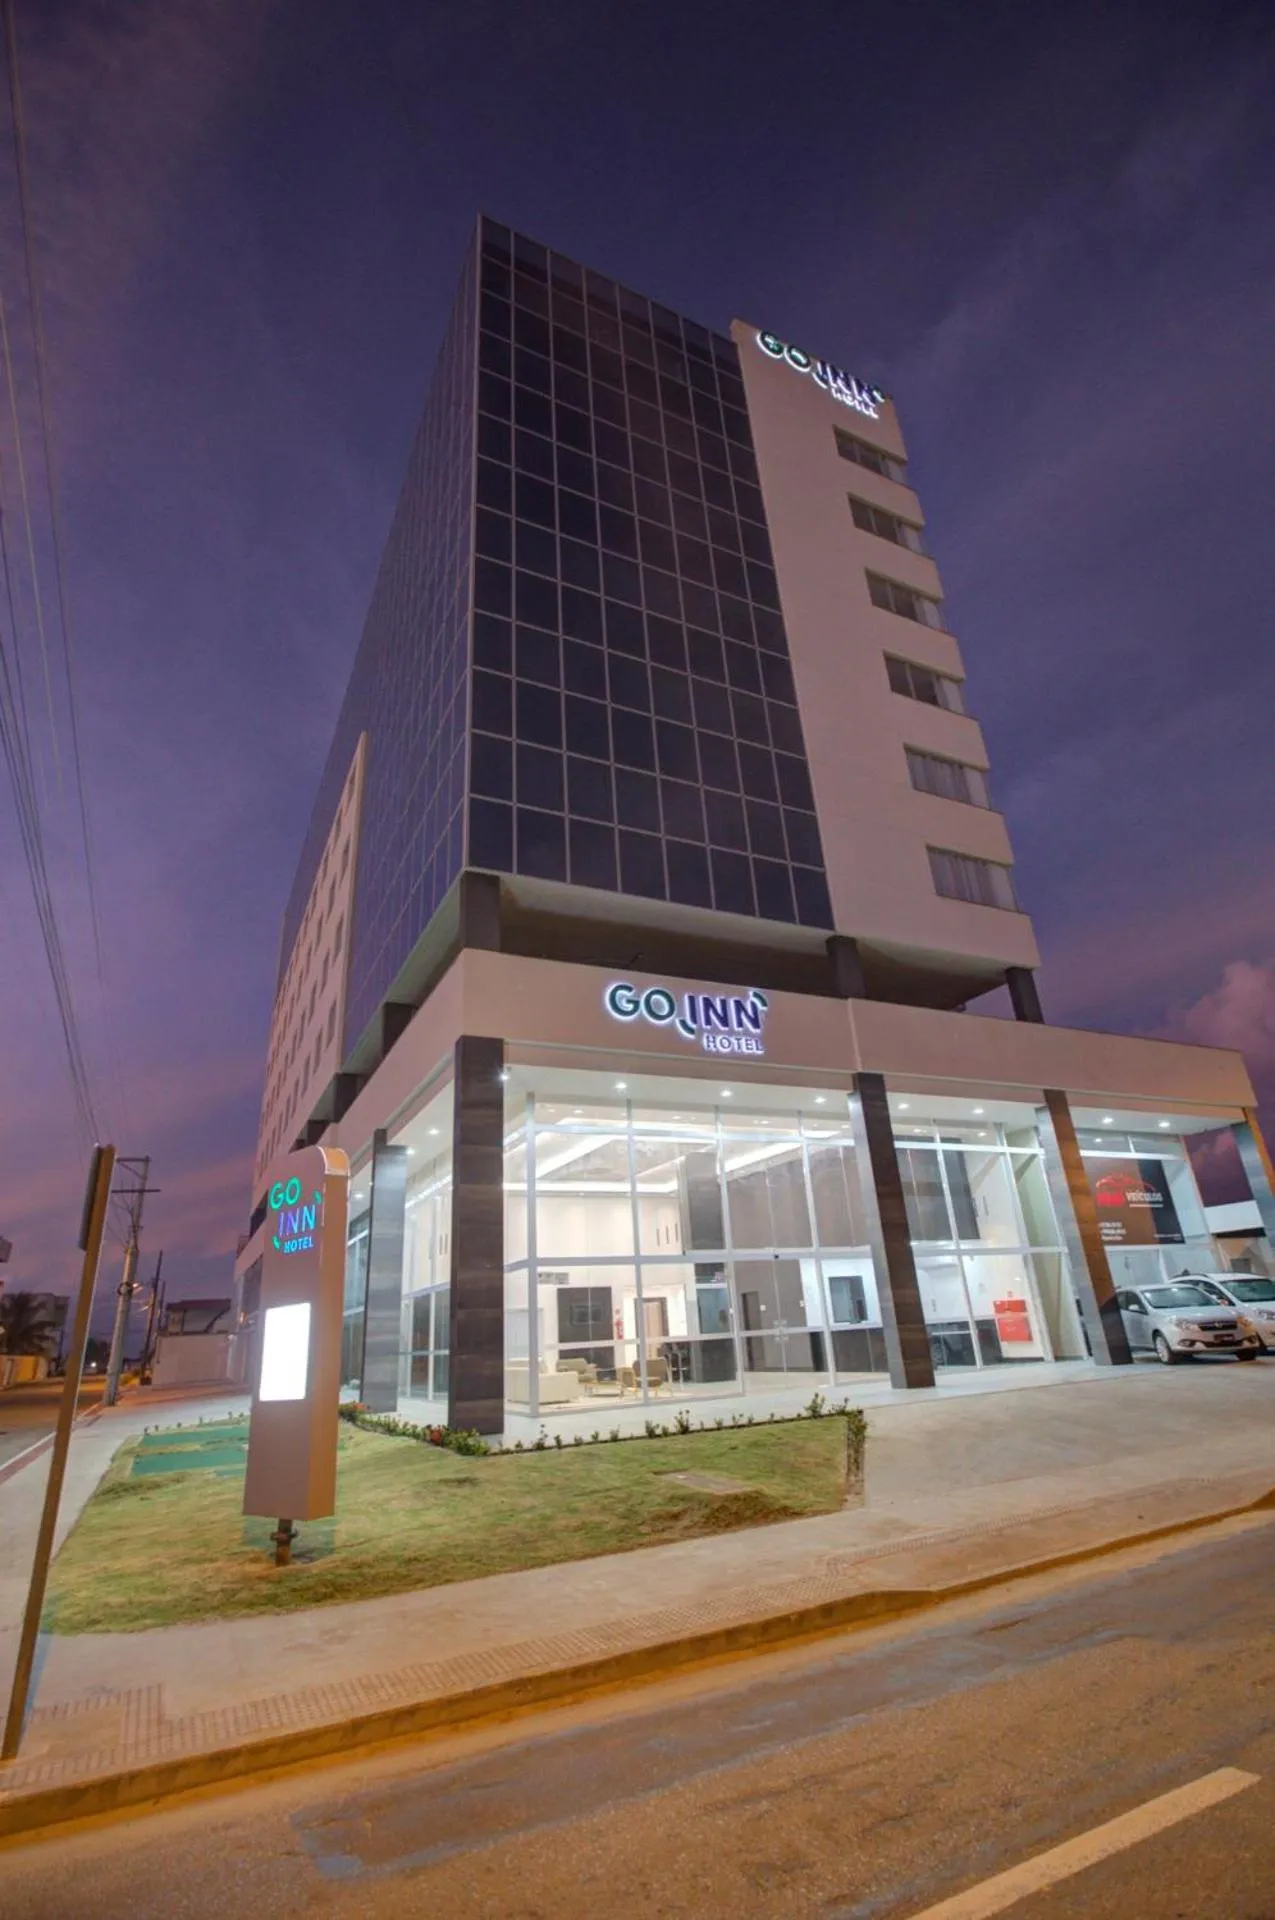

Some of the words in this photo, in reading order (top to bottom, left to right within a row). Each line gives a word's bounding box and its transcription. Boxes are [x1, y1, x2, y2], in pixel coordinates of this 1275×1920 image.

[756, 329, 812, 372] GO
[815, 359, 878, 408] INN
[607, 983, 676, 1022] GO
[685, 993, 762, 1031] INN
[704, 1033, 765, 1054] HOTEL
[269, 1176, 302, 1210] GO
[278, 1203, 316, 1238] INN
[282, 1235, 315, 1255] HOTEL
